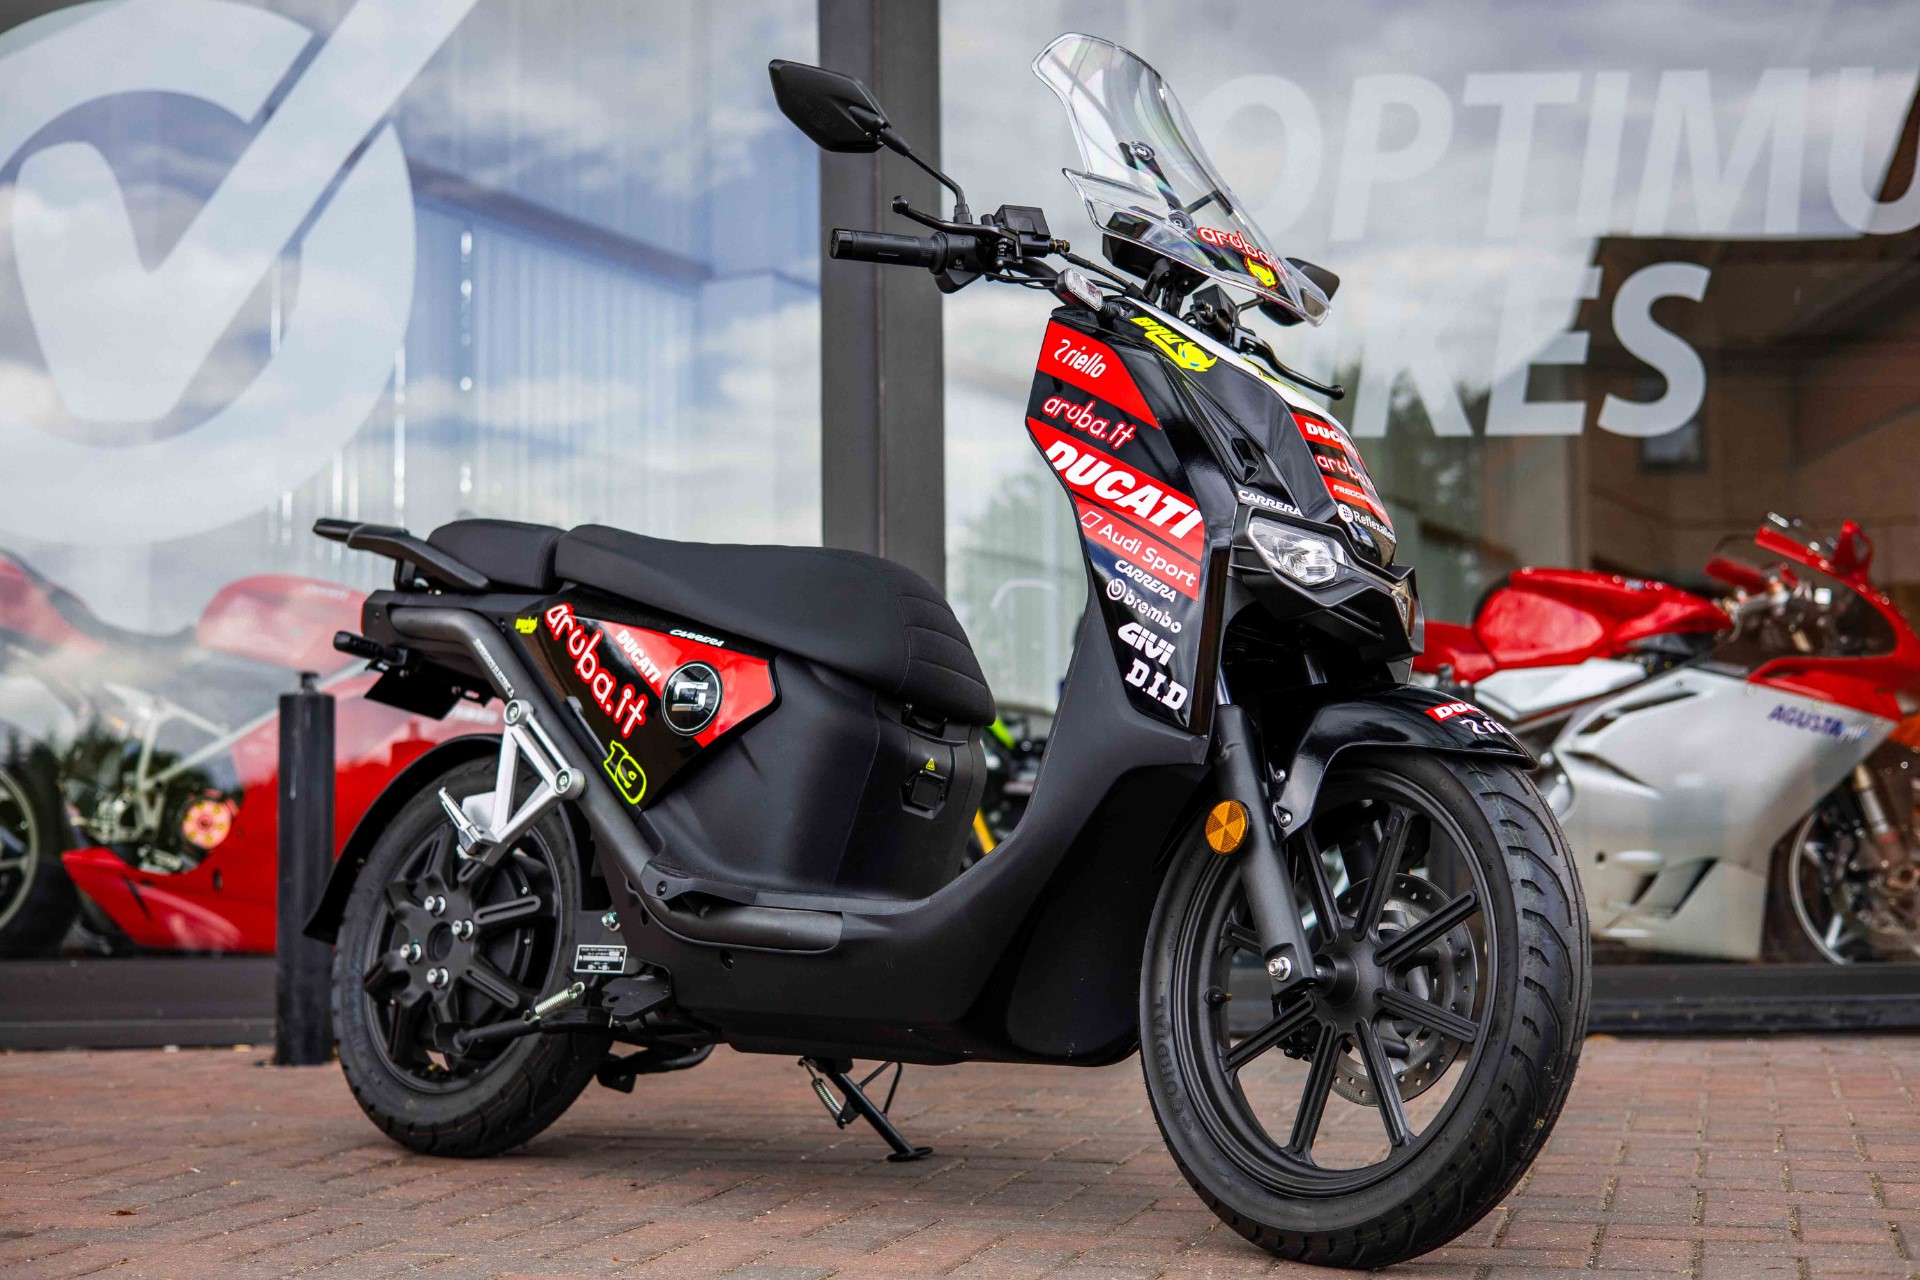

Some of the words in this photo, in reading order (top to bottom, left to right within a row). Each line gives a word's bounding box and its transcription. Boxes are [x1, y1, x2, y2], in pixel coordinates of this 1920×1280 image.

[1302, 261, 1711, 438] KES
[1043, 395, 1136, 450] aruba.it
[1045, 440, 1203, 540] DUCATI
[1238, 489, 1304, 518] CARRERA
[1097, 523, 1141, 556] Audi
[1141, 547, 1197, 587] Sport
[1115, 560, 1177, 602] CARRERA
[1123, 592, 1182, 633] brembo
[545, 603, 649, 738] aruba.it
[615, 629, 662, 684] DUCATI
[1117, 622, 1176, 666] GIVI
[1125, 658, 1188, 710] D.I.D
[1767, 704, 1843, 736] AGUSTA
